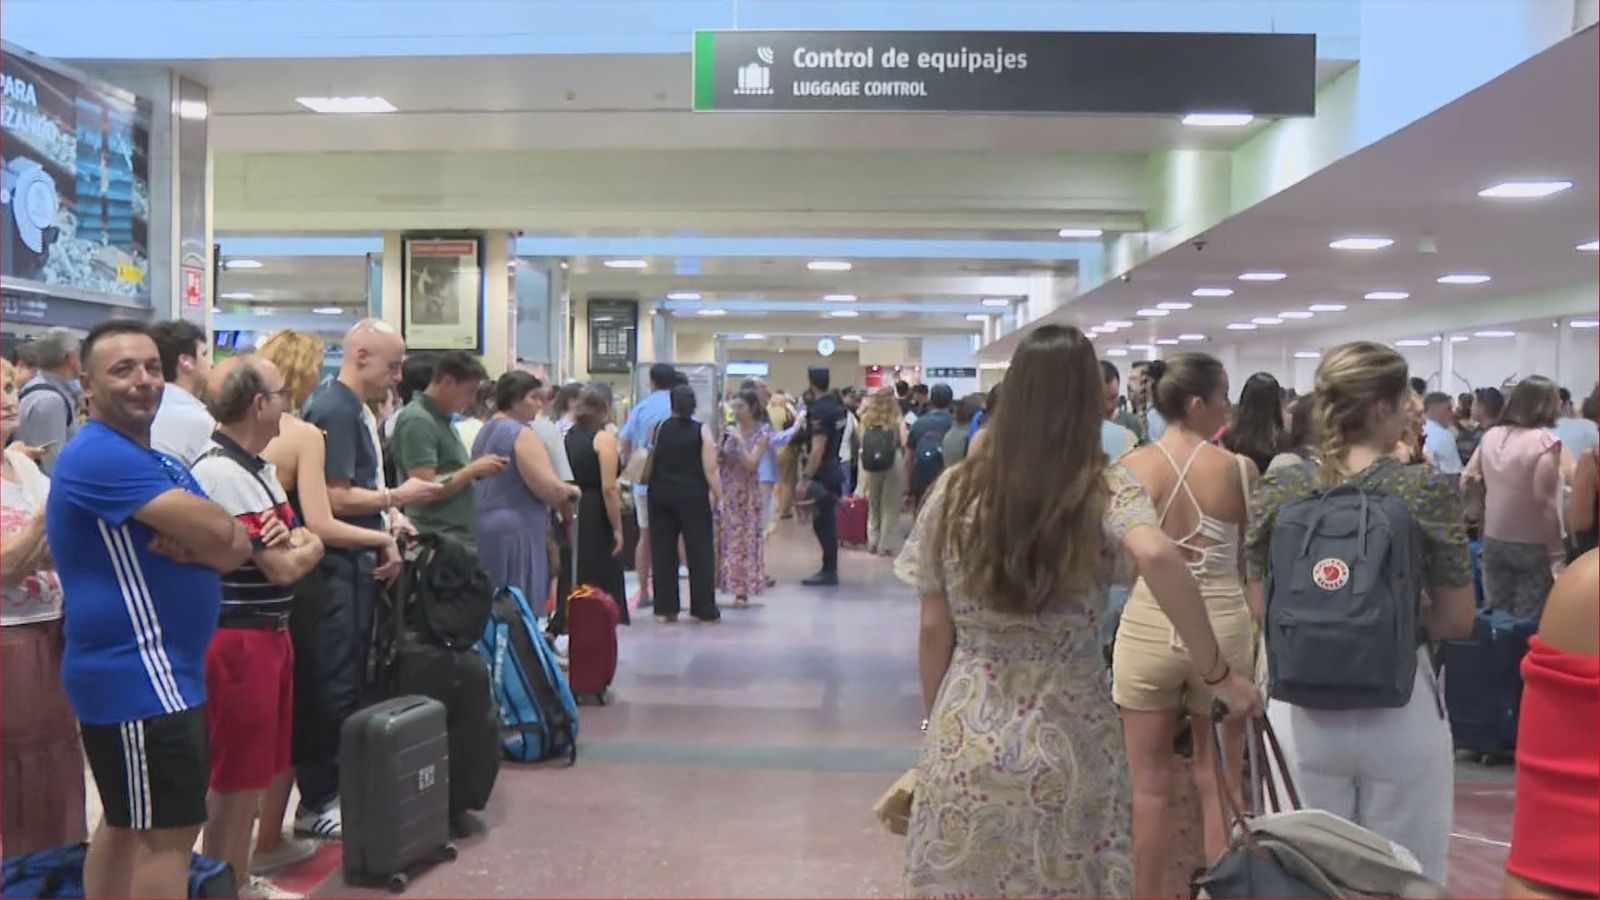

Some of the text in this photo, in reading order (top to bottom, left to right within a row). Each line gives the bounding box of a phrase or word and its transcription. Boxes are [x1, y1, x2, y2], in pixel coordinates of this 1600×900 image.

[793, 47, 1028, 73] Control de equipajes
[793, 81, 928, 96] LUGGAGE CONTROL
